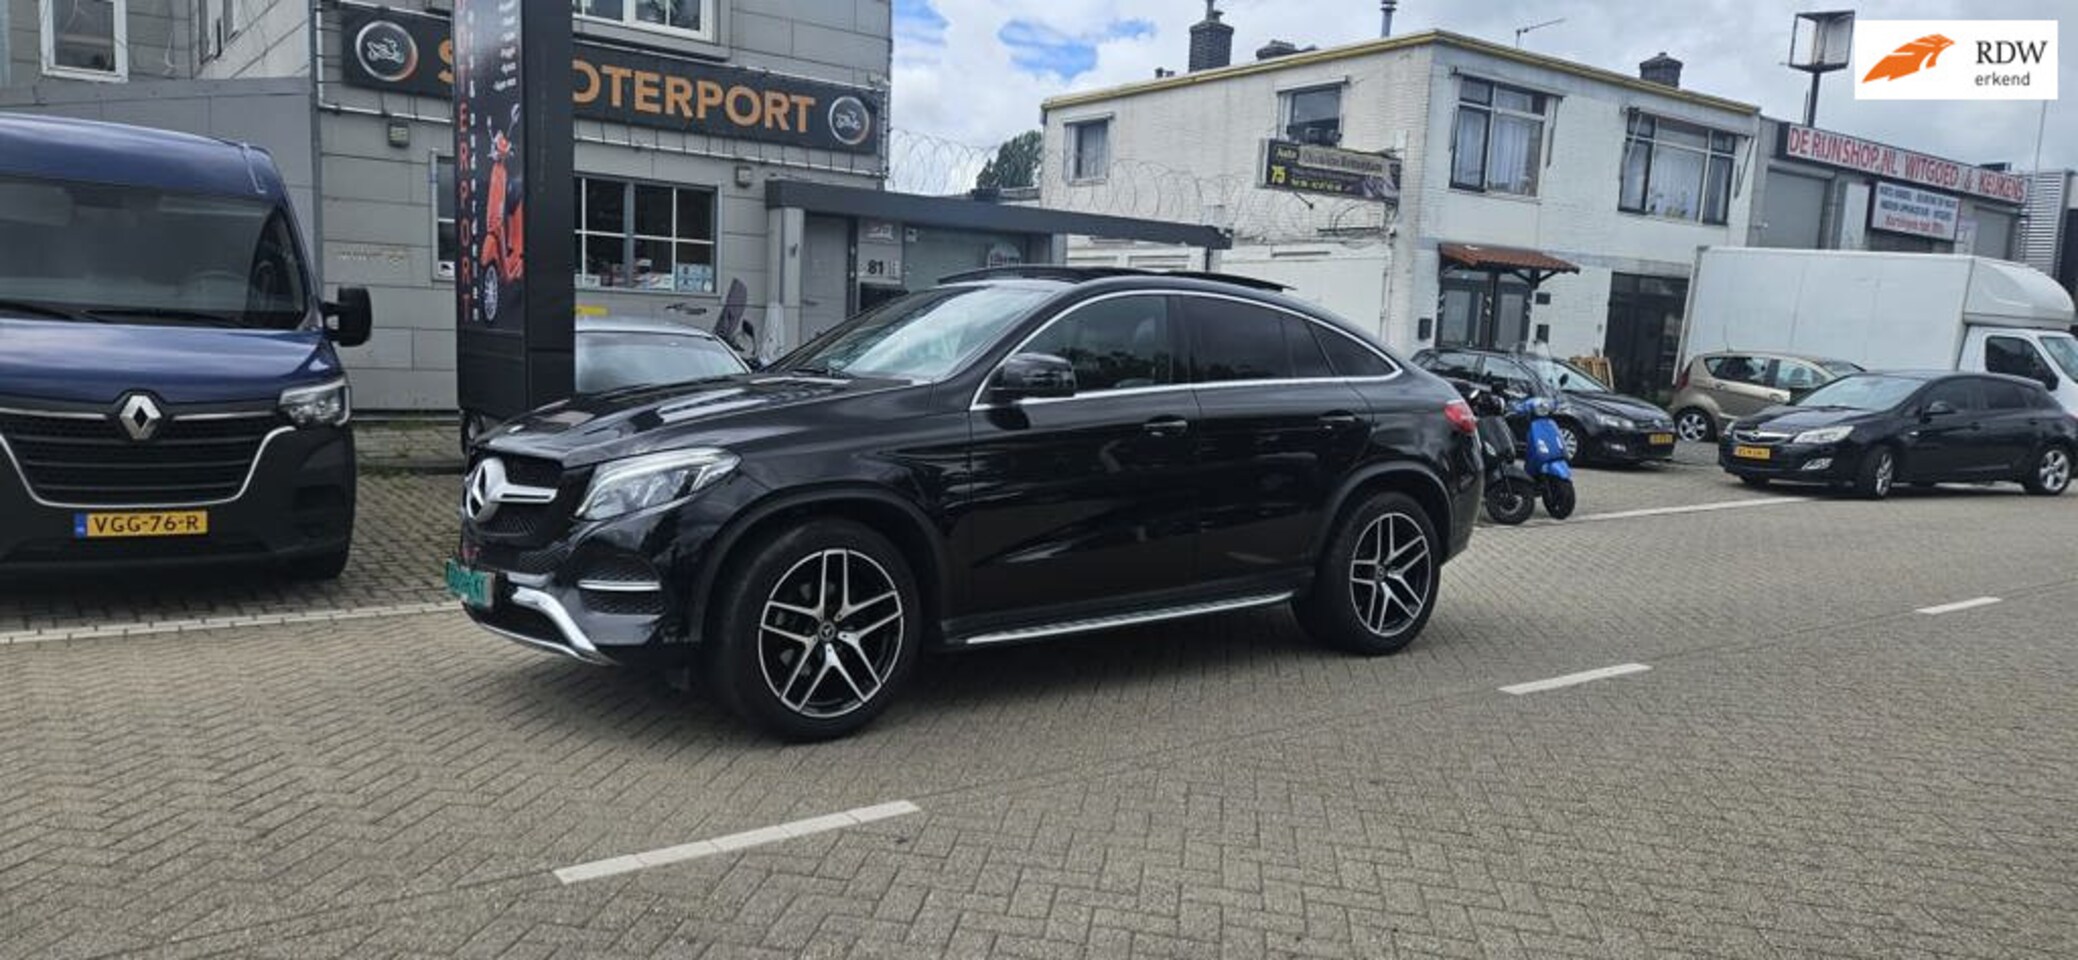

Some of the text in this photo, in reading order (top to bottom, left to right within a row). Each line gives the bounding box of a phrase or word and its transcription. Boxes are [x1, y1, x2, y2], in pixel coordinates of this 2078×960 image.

[1788, 127, 1810, 155] DE
[1903, 154, 1960, 187] WITGOED
[1979, 171, 2027, 202] KEUKENS
[1271, 166, 1286, 184] 75
[867, 259, 884, 275] 81
[94, 514, 199, 533] VGG-76-R
